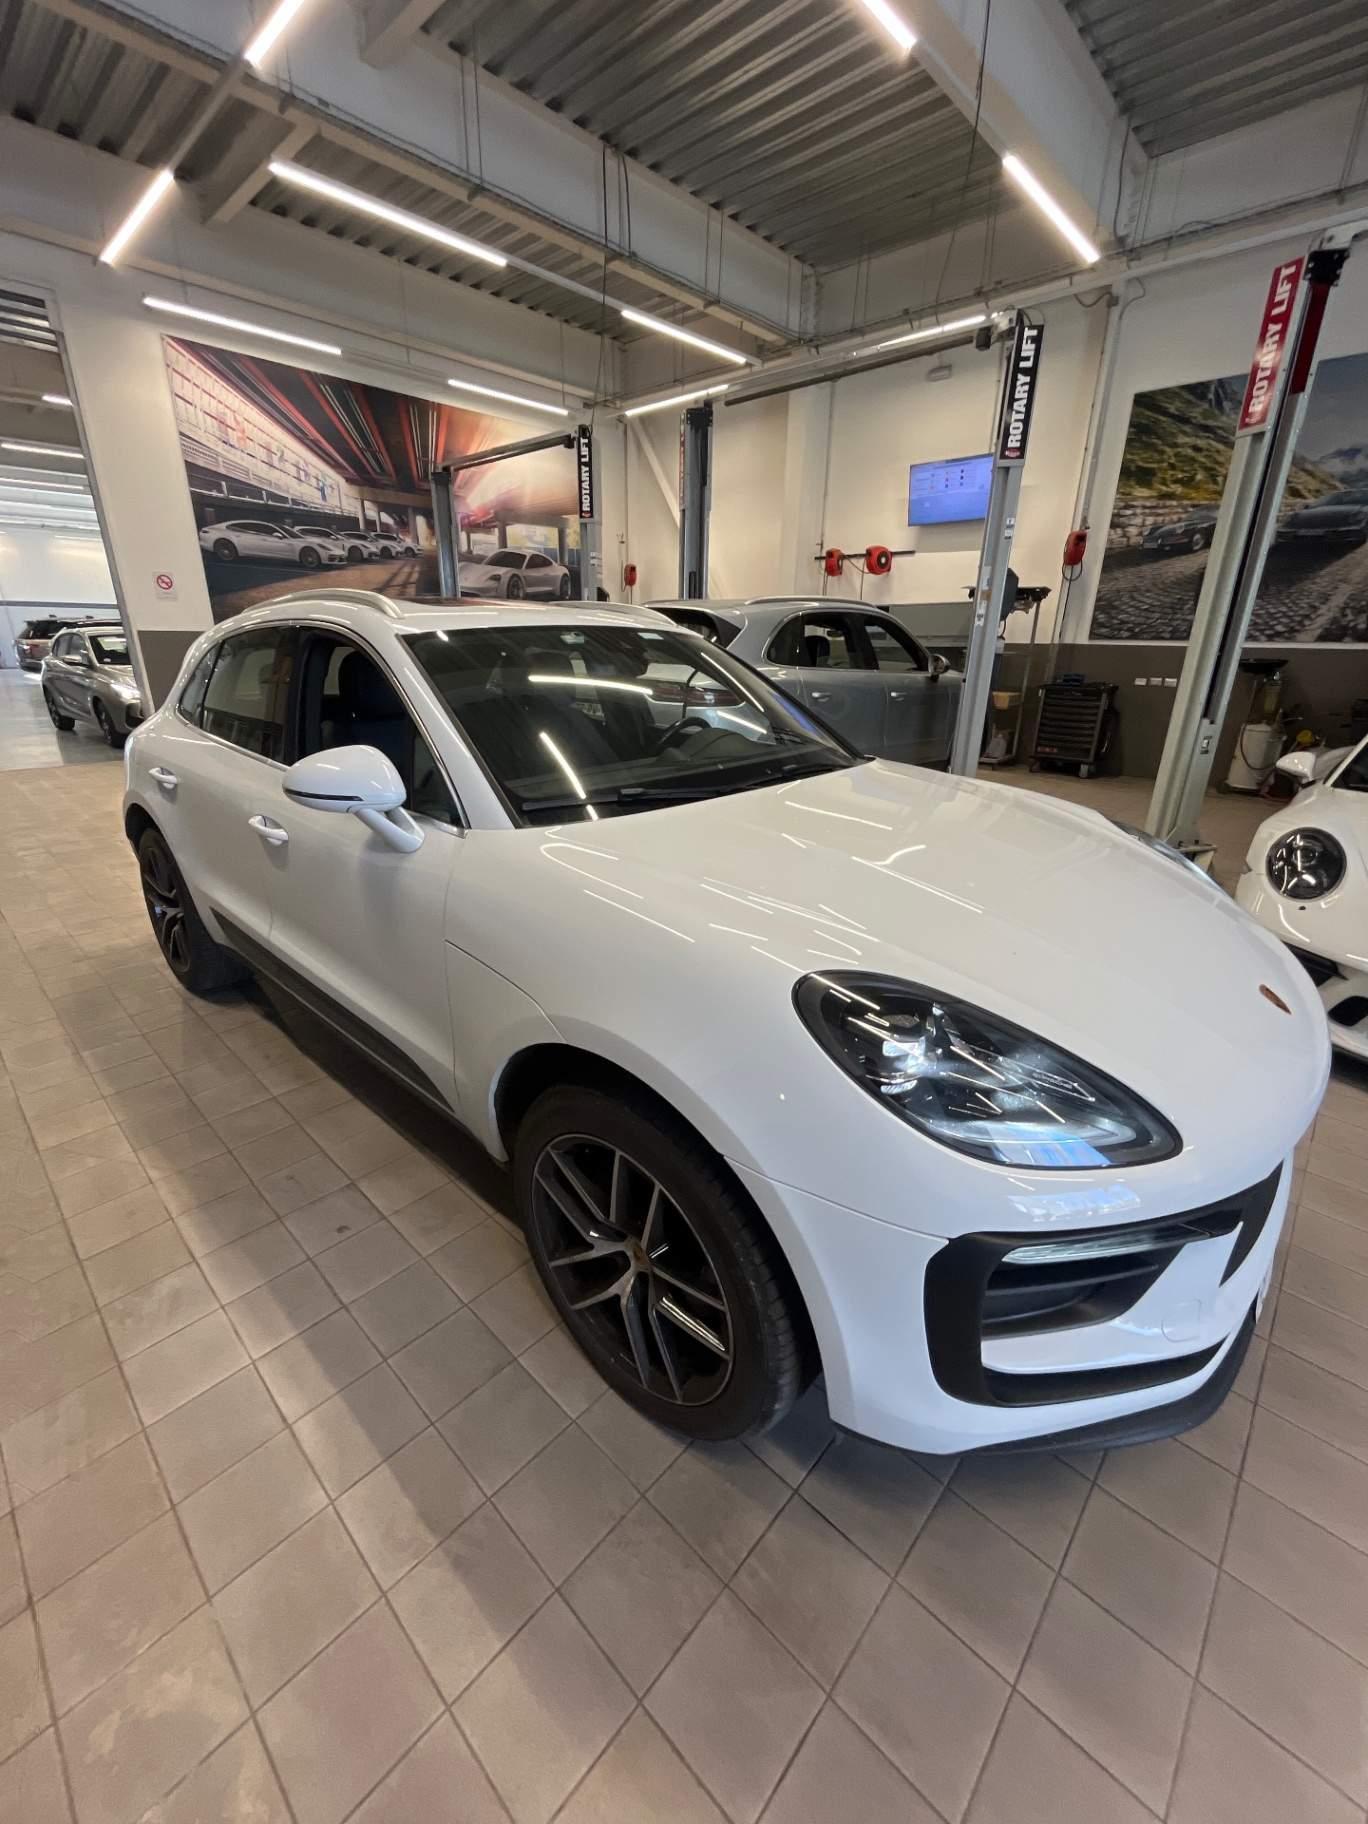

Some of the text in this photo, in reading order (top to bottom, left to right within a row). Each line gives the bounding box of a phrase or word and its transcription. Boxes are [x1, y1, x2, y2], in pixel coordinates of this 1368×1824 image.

[1007, 327, 1038, 448] ROTARY LIFT
[1248, 264, 1297, 414] ROTARY LIFT
[580, 437, 591, 511] ROTARY LIFT
